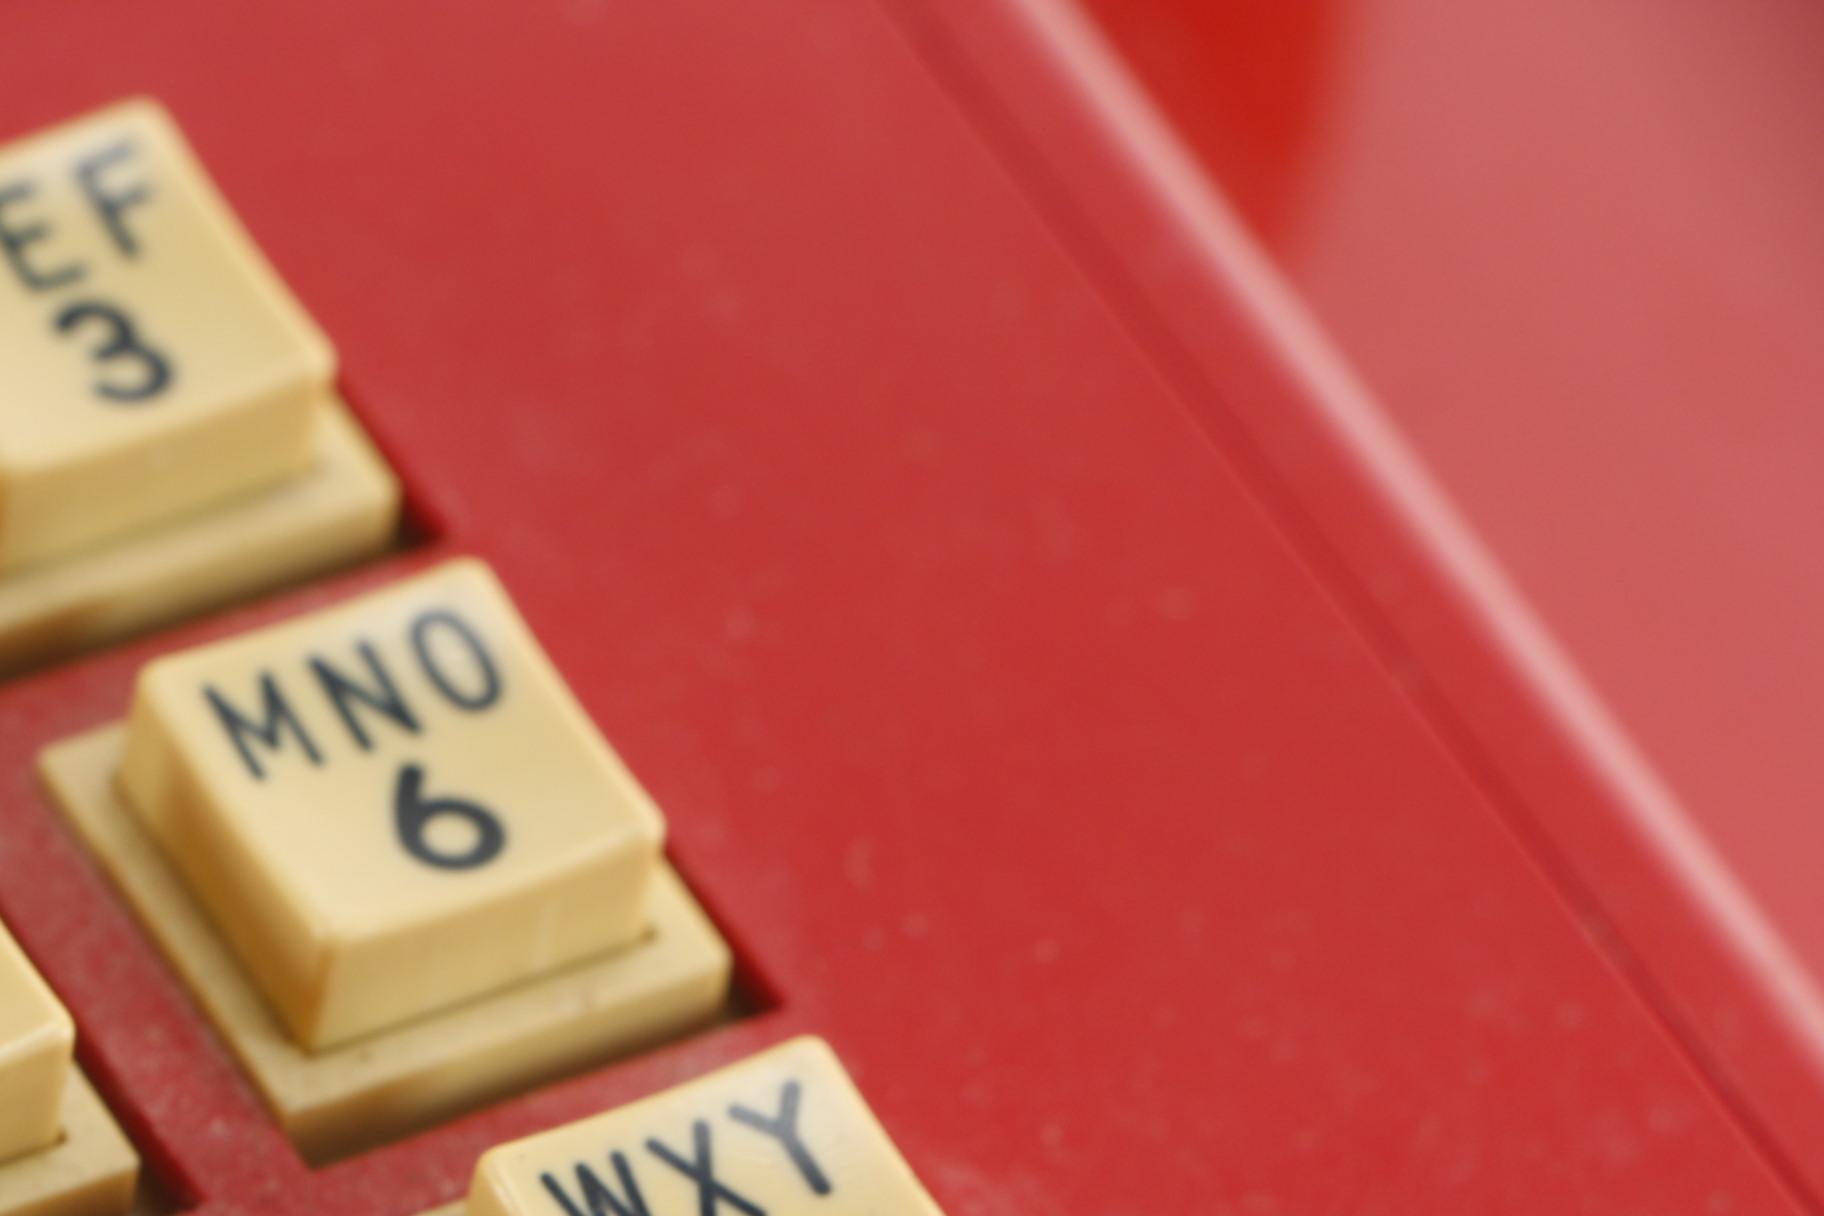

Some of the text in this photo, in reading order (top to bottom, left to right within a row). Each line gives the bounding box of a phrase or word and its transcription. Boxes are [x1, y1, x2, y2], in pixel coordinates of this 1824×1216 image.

[58, 303, 173, 400] 3
[204, 608, 502, 777] MNO
[395, 764, 504, 870] 6
